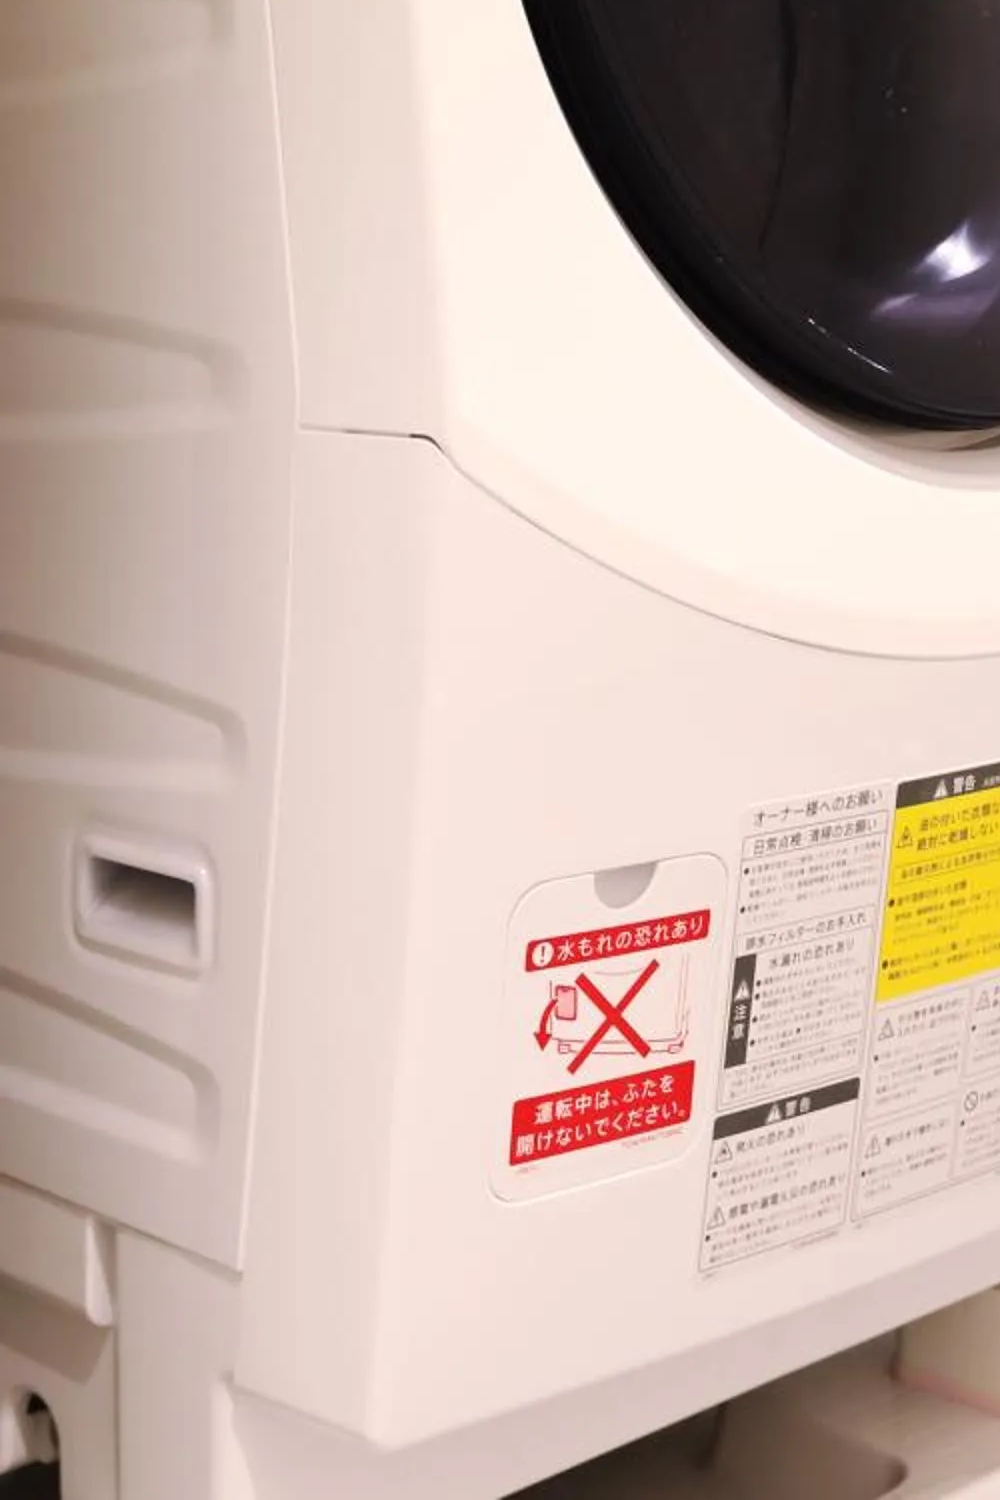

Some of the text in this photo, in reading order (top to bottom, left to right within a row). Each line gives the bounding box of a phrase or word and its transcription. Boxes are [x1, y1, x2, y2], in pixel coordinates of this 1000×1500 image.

[754, 789, 884, 828] オーナー様へのお願い
[556, 914, 705, 961] 水もれの恐れあり
[533, 1073, 674, 1126] 運転中は、ふたを
[515, 1100, 686, 1158] 開けないでください。
